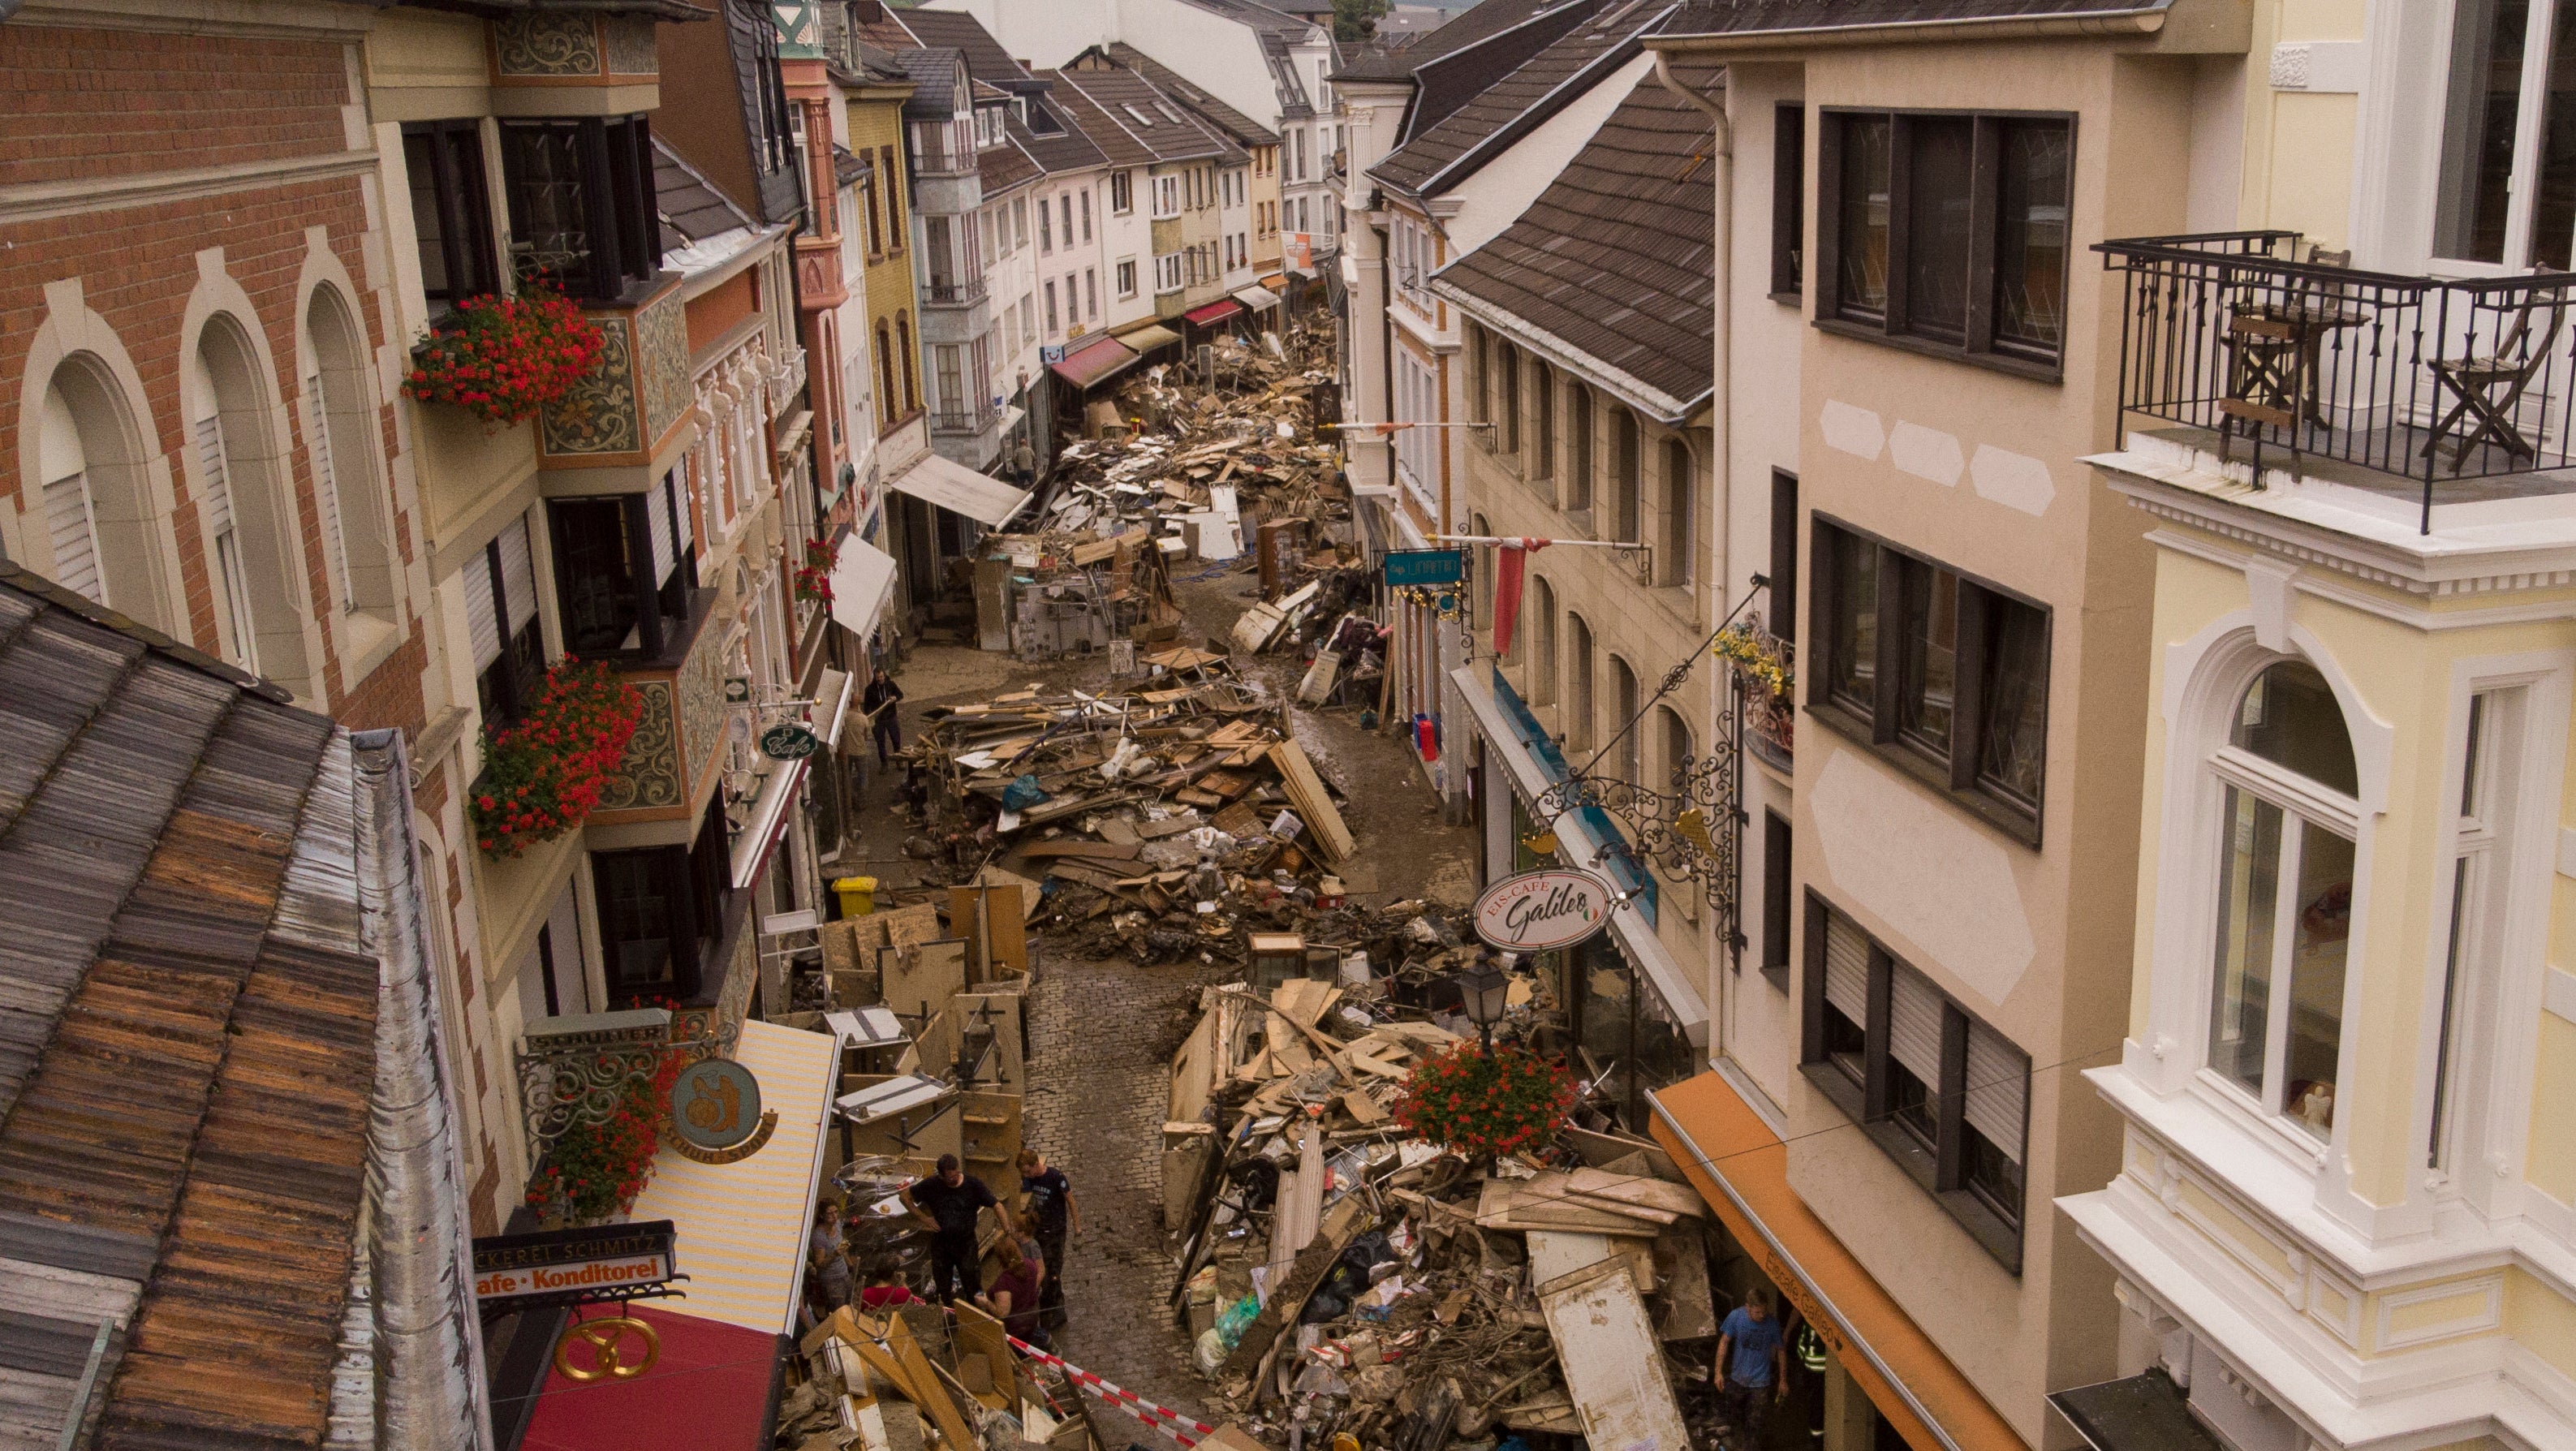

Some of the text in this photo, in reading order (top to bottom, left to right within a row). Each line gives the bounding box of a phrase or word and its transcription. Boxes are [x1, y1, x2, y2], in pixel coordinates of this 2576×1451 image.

[1486, 881, 1549, 917] EIS-CAFE
[1506, 883, 1587, 944] Galileo
[474, 1237, 655, 1268] CKEREI SCHMITZ
[476, 1259, 658, 1295] afe Konditorei
